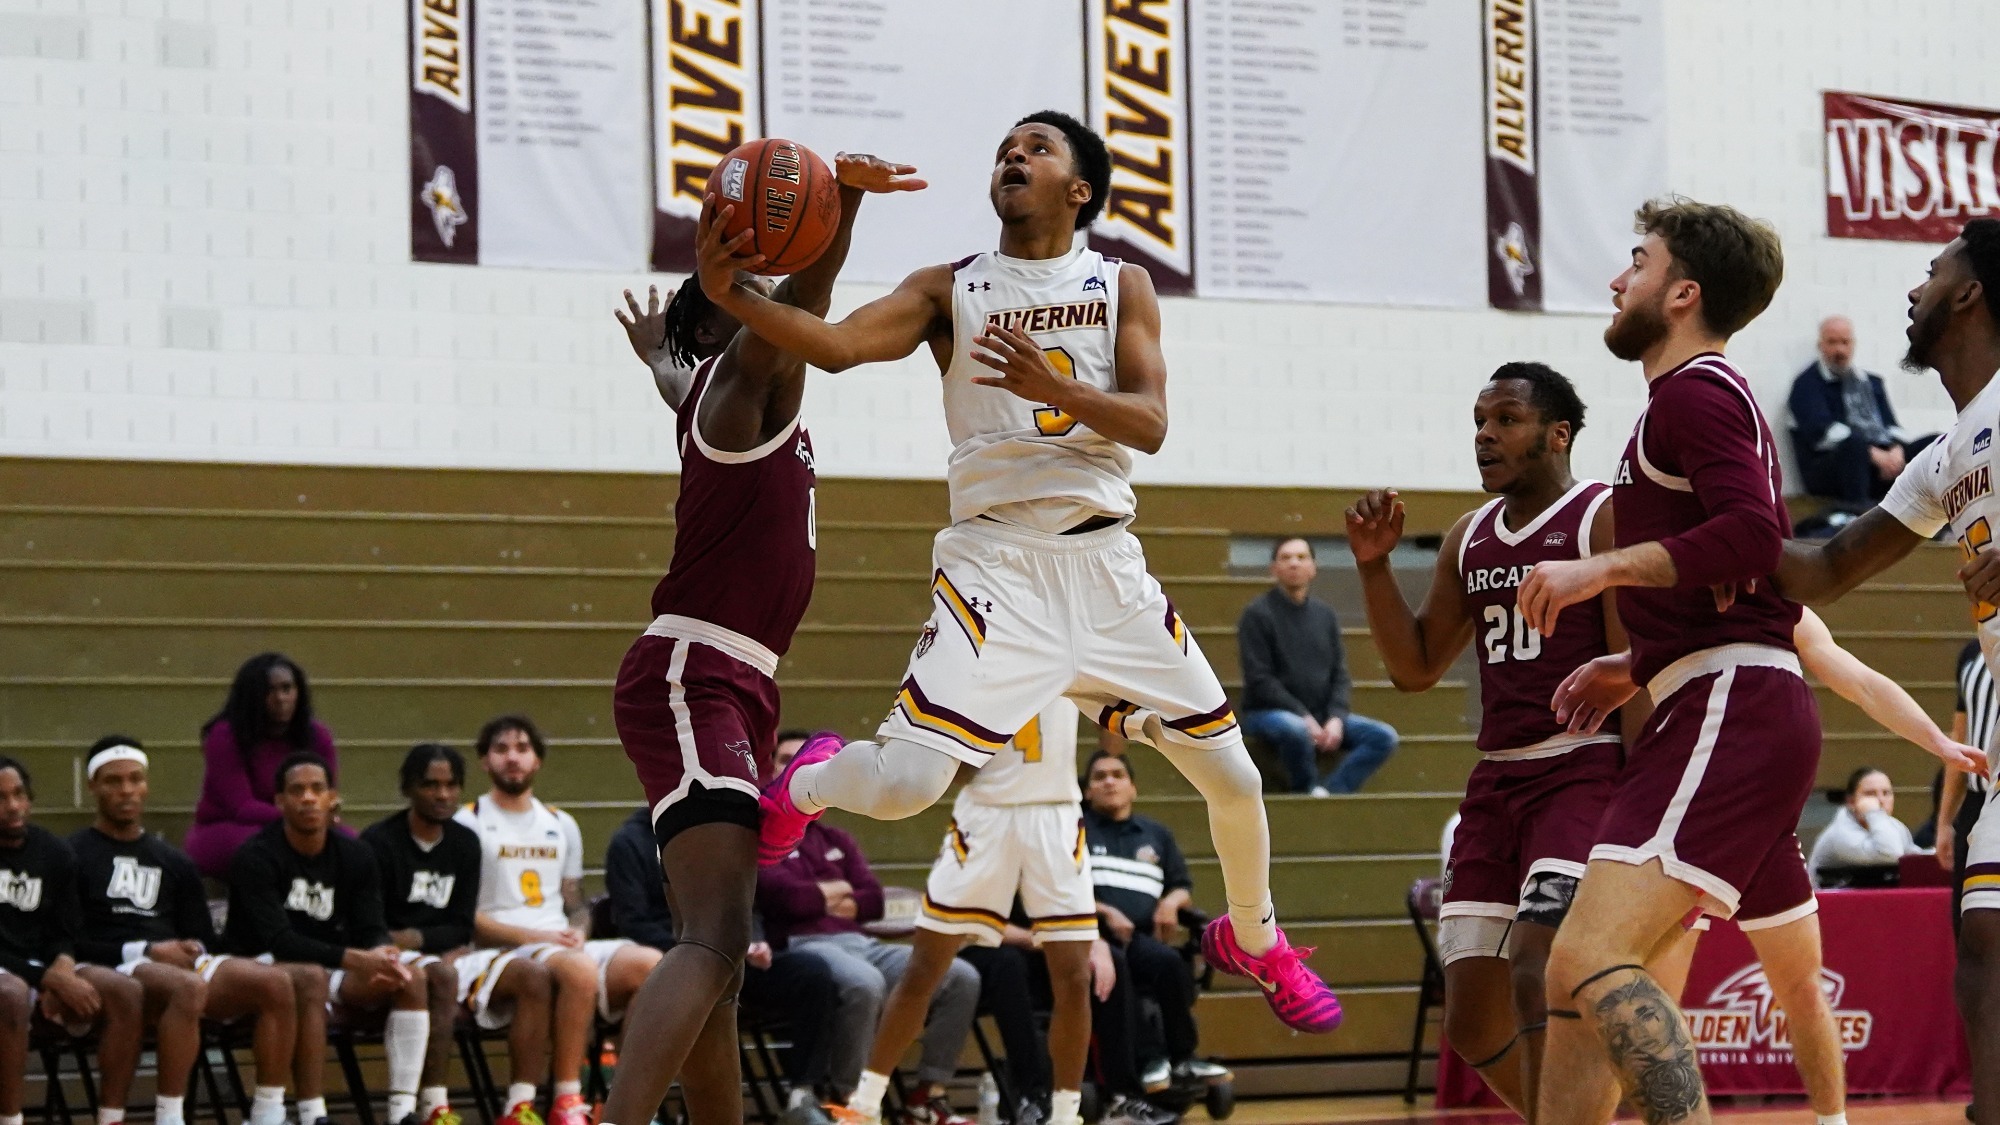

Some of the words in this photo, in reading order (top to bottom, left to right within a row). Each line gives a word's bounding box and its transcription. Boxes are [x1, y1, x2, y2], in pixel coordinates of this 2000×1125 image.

[766, 187, 797, 233] THE
[1483, 603, 1542, 665] 20
[106, 855, 163, 910] AU
